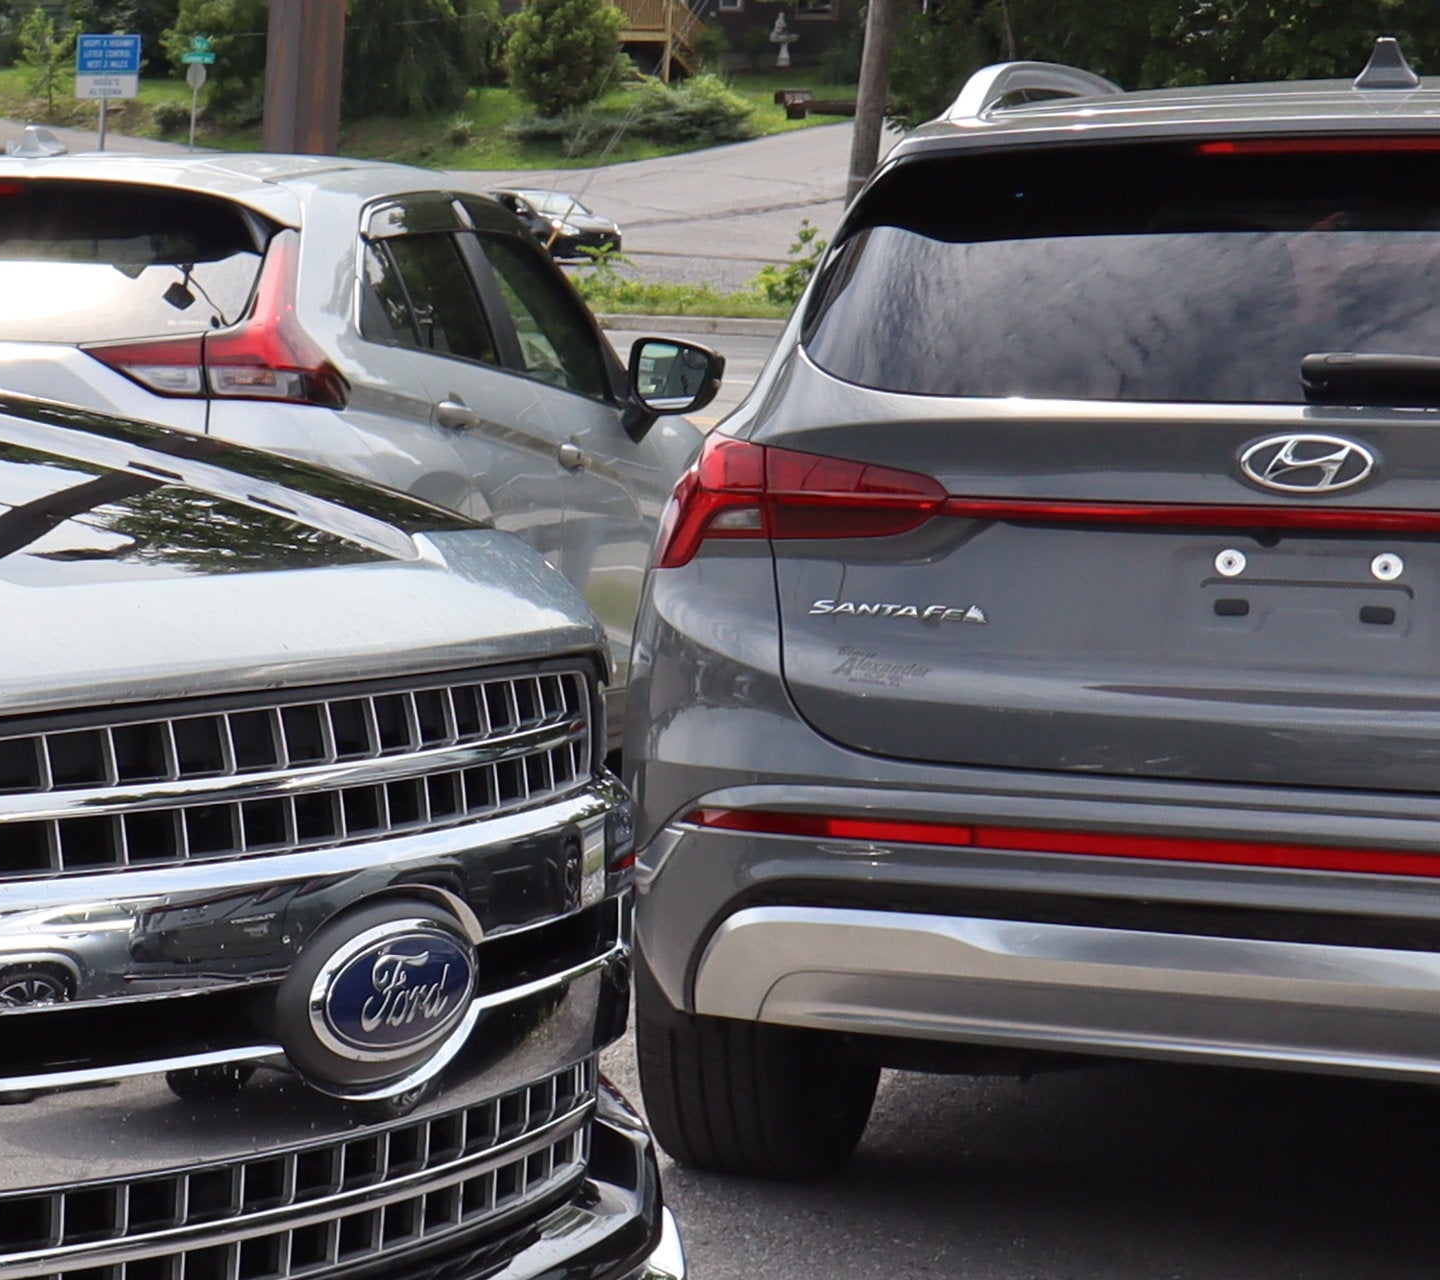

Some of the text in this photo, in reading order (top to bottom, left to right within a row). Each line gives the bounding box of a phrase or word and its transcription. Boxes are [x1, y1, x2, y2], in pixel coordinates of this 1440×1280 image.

[808, 599, 964, 622] SANTA FE
[832, 656, 933, 678] Alexander
[360, 950, 451, 1033] Ford
